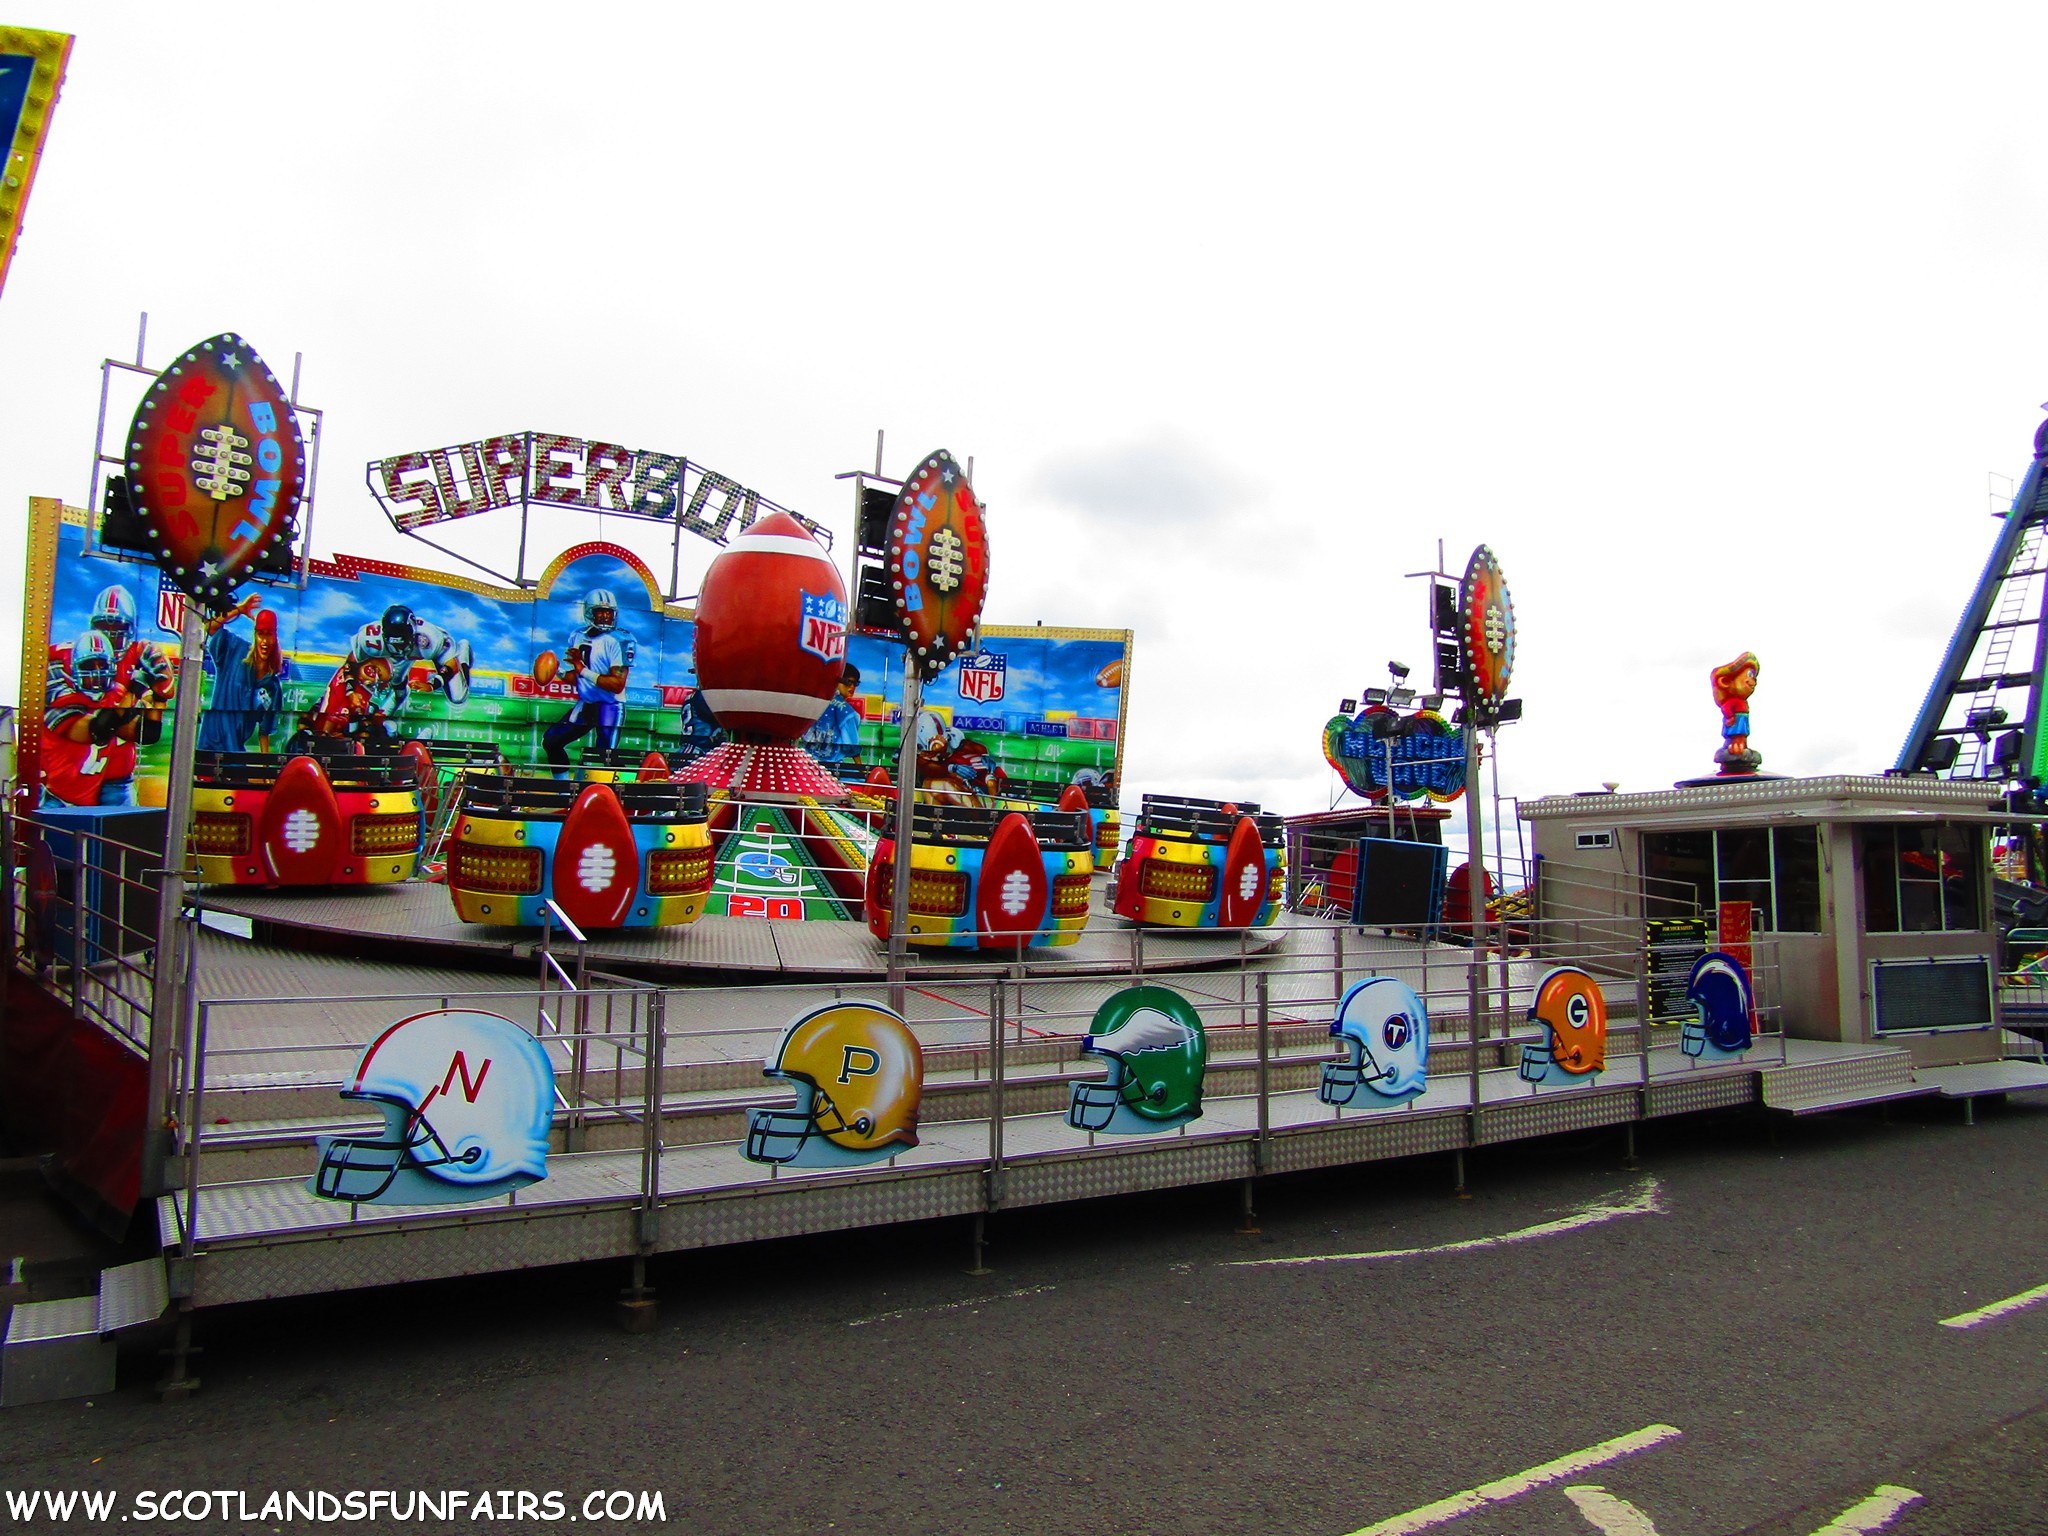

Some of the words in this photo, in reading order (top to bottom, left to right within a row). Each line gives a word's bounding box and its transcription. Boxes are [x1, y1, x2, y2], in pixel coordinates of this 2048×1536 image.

[158, 375, 217, 540] SUPER
[228, 401, 283, 543] BOWL
[381, 433, 820, 543] SUPERBO
[903, 492, 938, 612] BOWL
[953, 488, 981, 626] SUPER
[160, 592, 186, 632] NF
[807, 618, 844, 657] NFL
[540, 682, 578, 694] ree
[664, 687, 693, 703] NF
[962, 670, 1002, 700] NFL
[1566, 993, 1589, 1029] G
[1388, 1024, 1405, 1045] T
[439, 1049, 492, 1104] N
[837, 1044, 882, 1085] P
